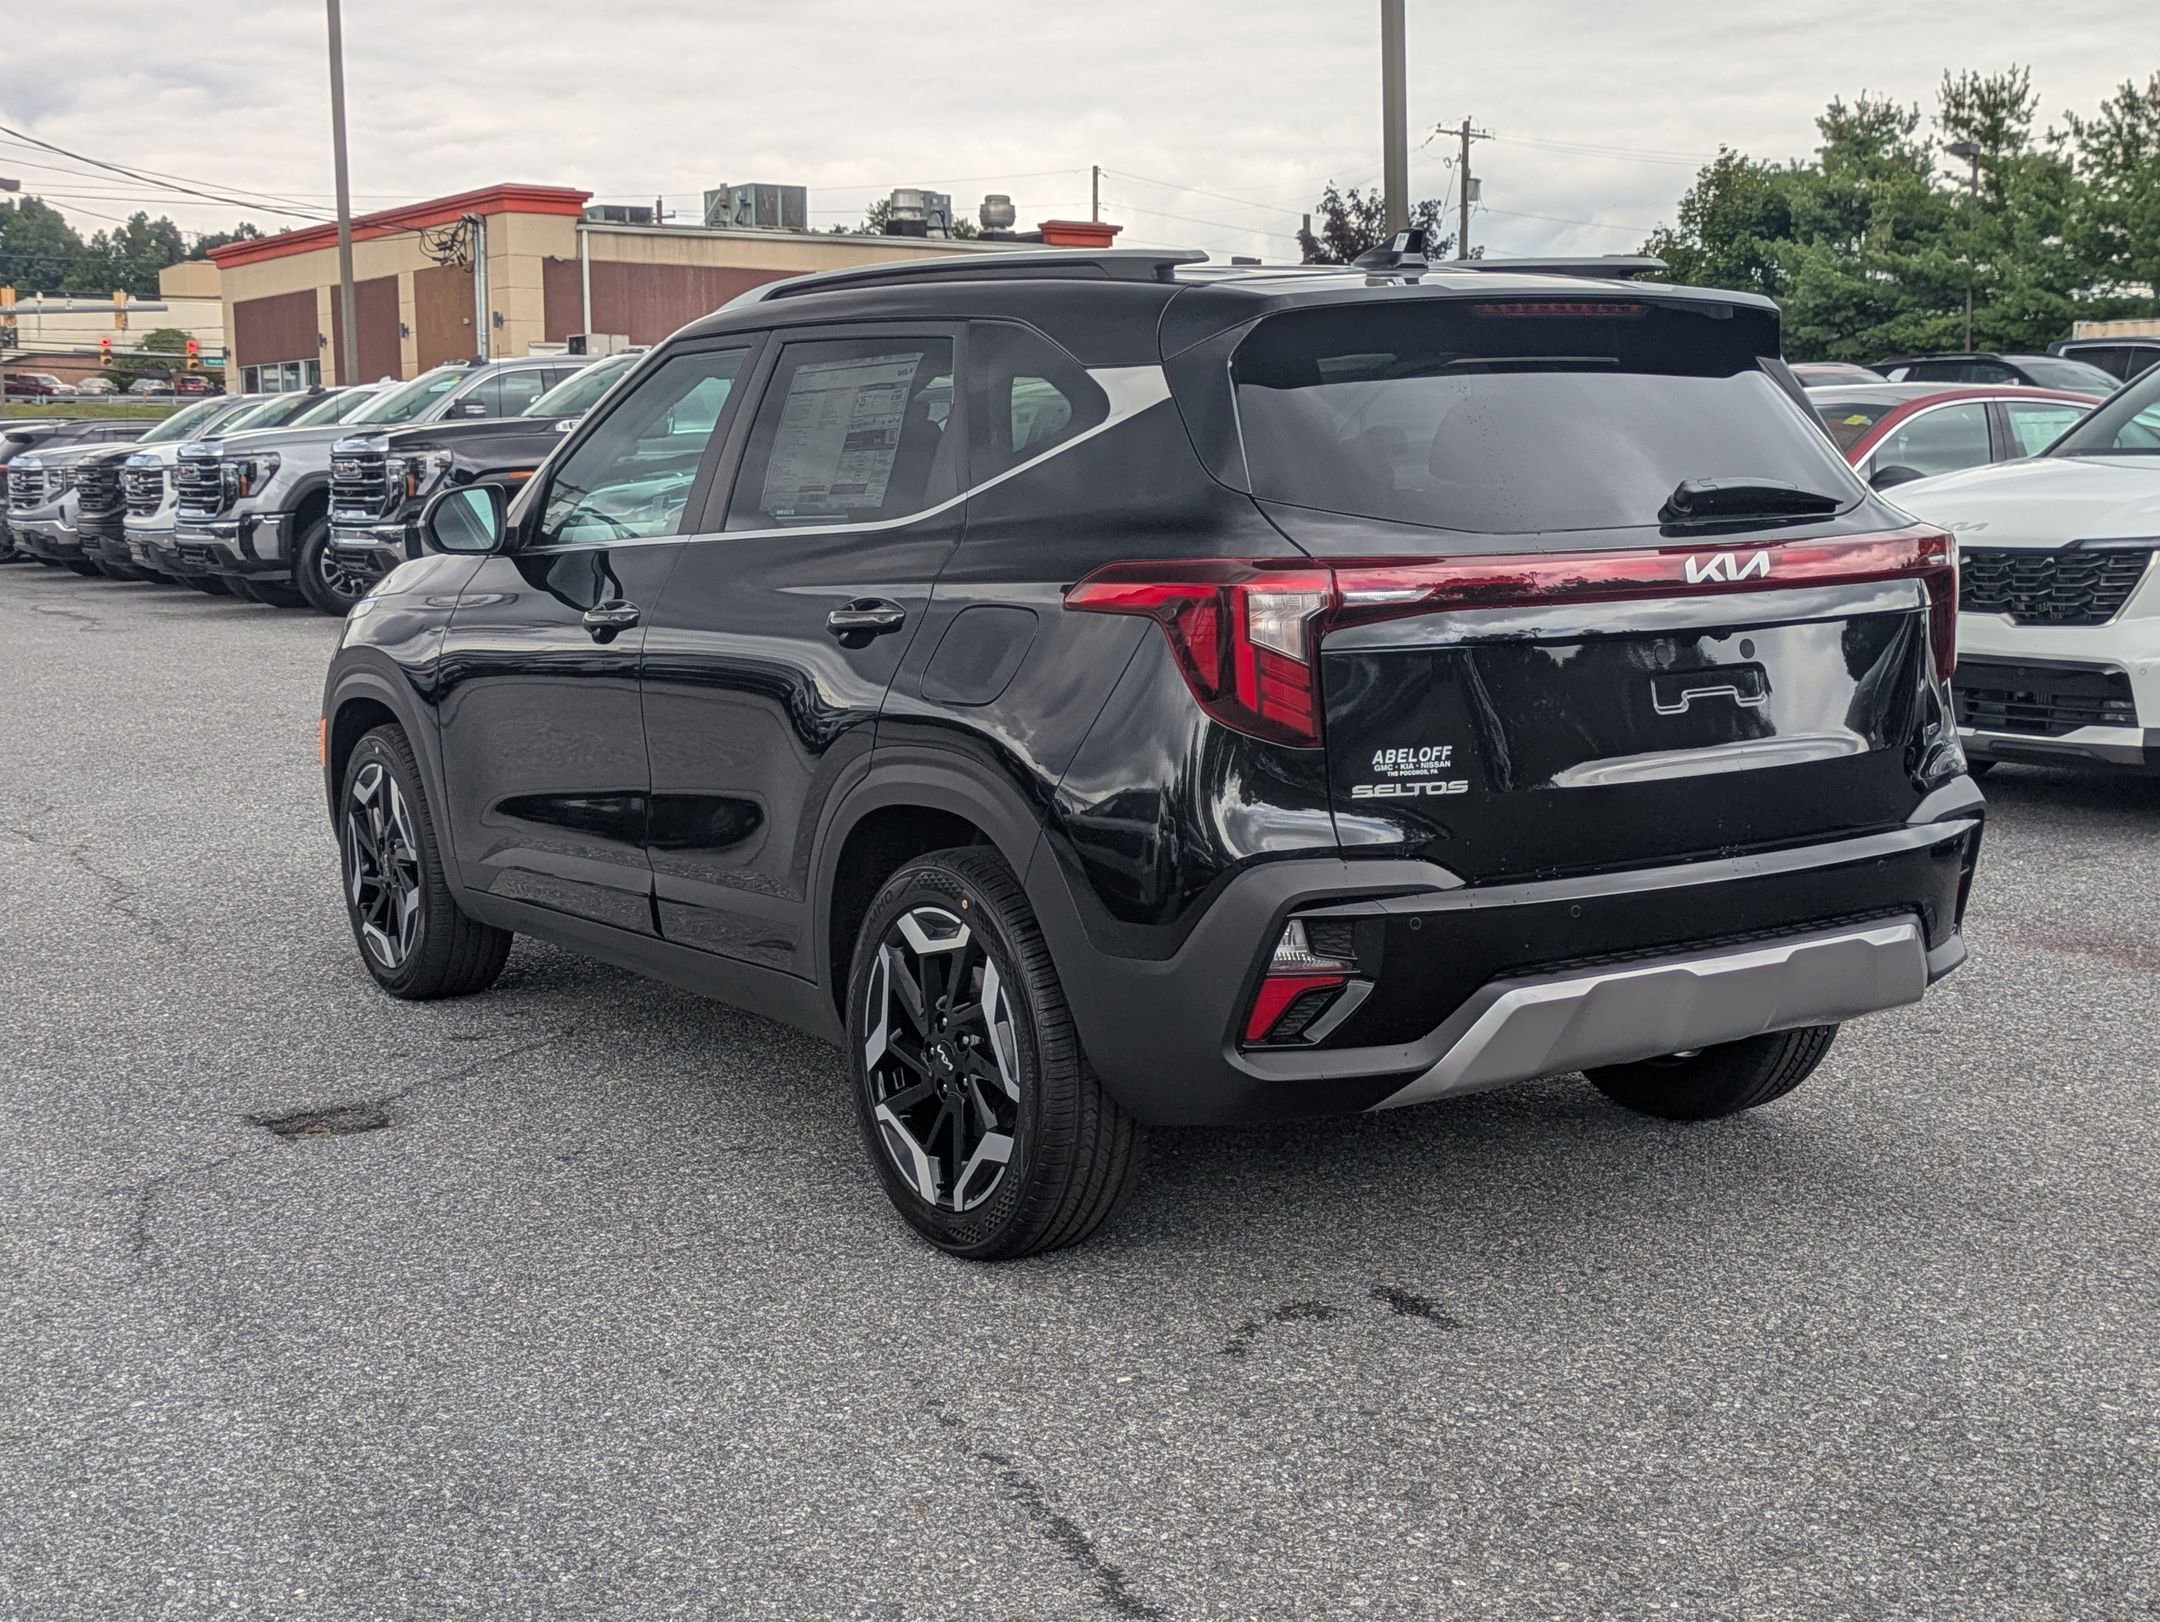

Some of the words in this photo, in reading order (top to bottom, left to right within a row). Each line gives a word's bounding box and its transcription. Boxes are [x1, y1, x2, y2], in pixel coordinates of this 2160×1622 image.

[1685, 551, 1770, 584] KIA
[1372, 745, 1453, 765] ABELOFF
[1374, 764, 1393, 772] GMC
[1420, 760, 1451, 769] NISSAN
[1351, 780, 1469, 799] SELTOS
